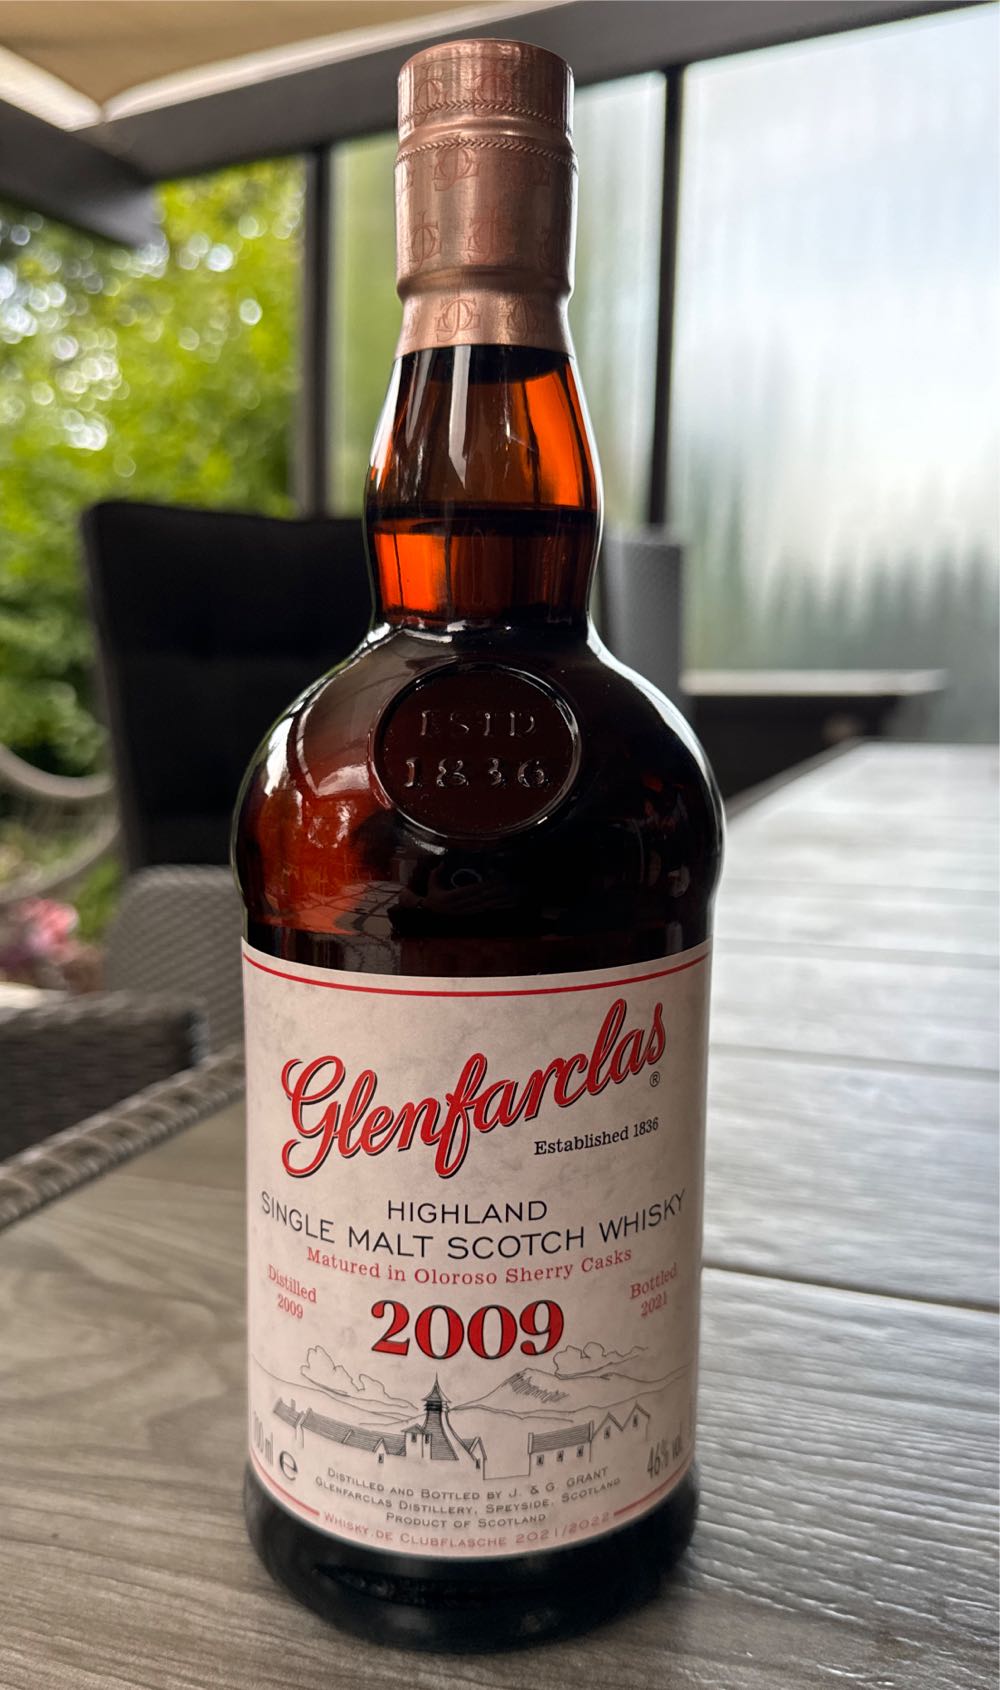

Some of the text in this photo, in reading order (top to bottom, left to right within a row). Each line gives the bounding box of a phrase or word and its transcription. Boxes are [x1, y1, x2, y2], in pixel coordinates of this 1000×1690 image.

[404, 757, 550, 790] 1836
[281, 998, 666, 1178] Glenfarclas
[534, 1117, 660, 1155] Established 1836
[261, 1188, 686, 1260] SINGLE MALT SCOTCH WHISKY
[388, 1200, 548, 1224] HIGHLAND
[268, 1264, 318, 1304] Distilled
[306, 1246, 632, 1285] Matured in Oloroso Sherry Casks
[629, 1262, 678, 1300] Bottled
[277, 1293, 304, 1320] 2009
[640, 1291, 668, 1317] 2021
[370, 1299, 565, 1360] 2009
[390, 1487, 414, 1497] AND
[487, 1489, 501, 1500] BY
[530, 1485, 539, 1496] &
[566, 1466, 608, 1488] GRANT
[561, 1477, 621, 1503] SCOTLAND
[386, 1512, 546, 1529] PRODUCT OF SCOTLAND
[400, 1532, 507, 1549] CLUBFLASCHE
[515, 1511, 610, 1544] 2021/2022
